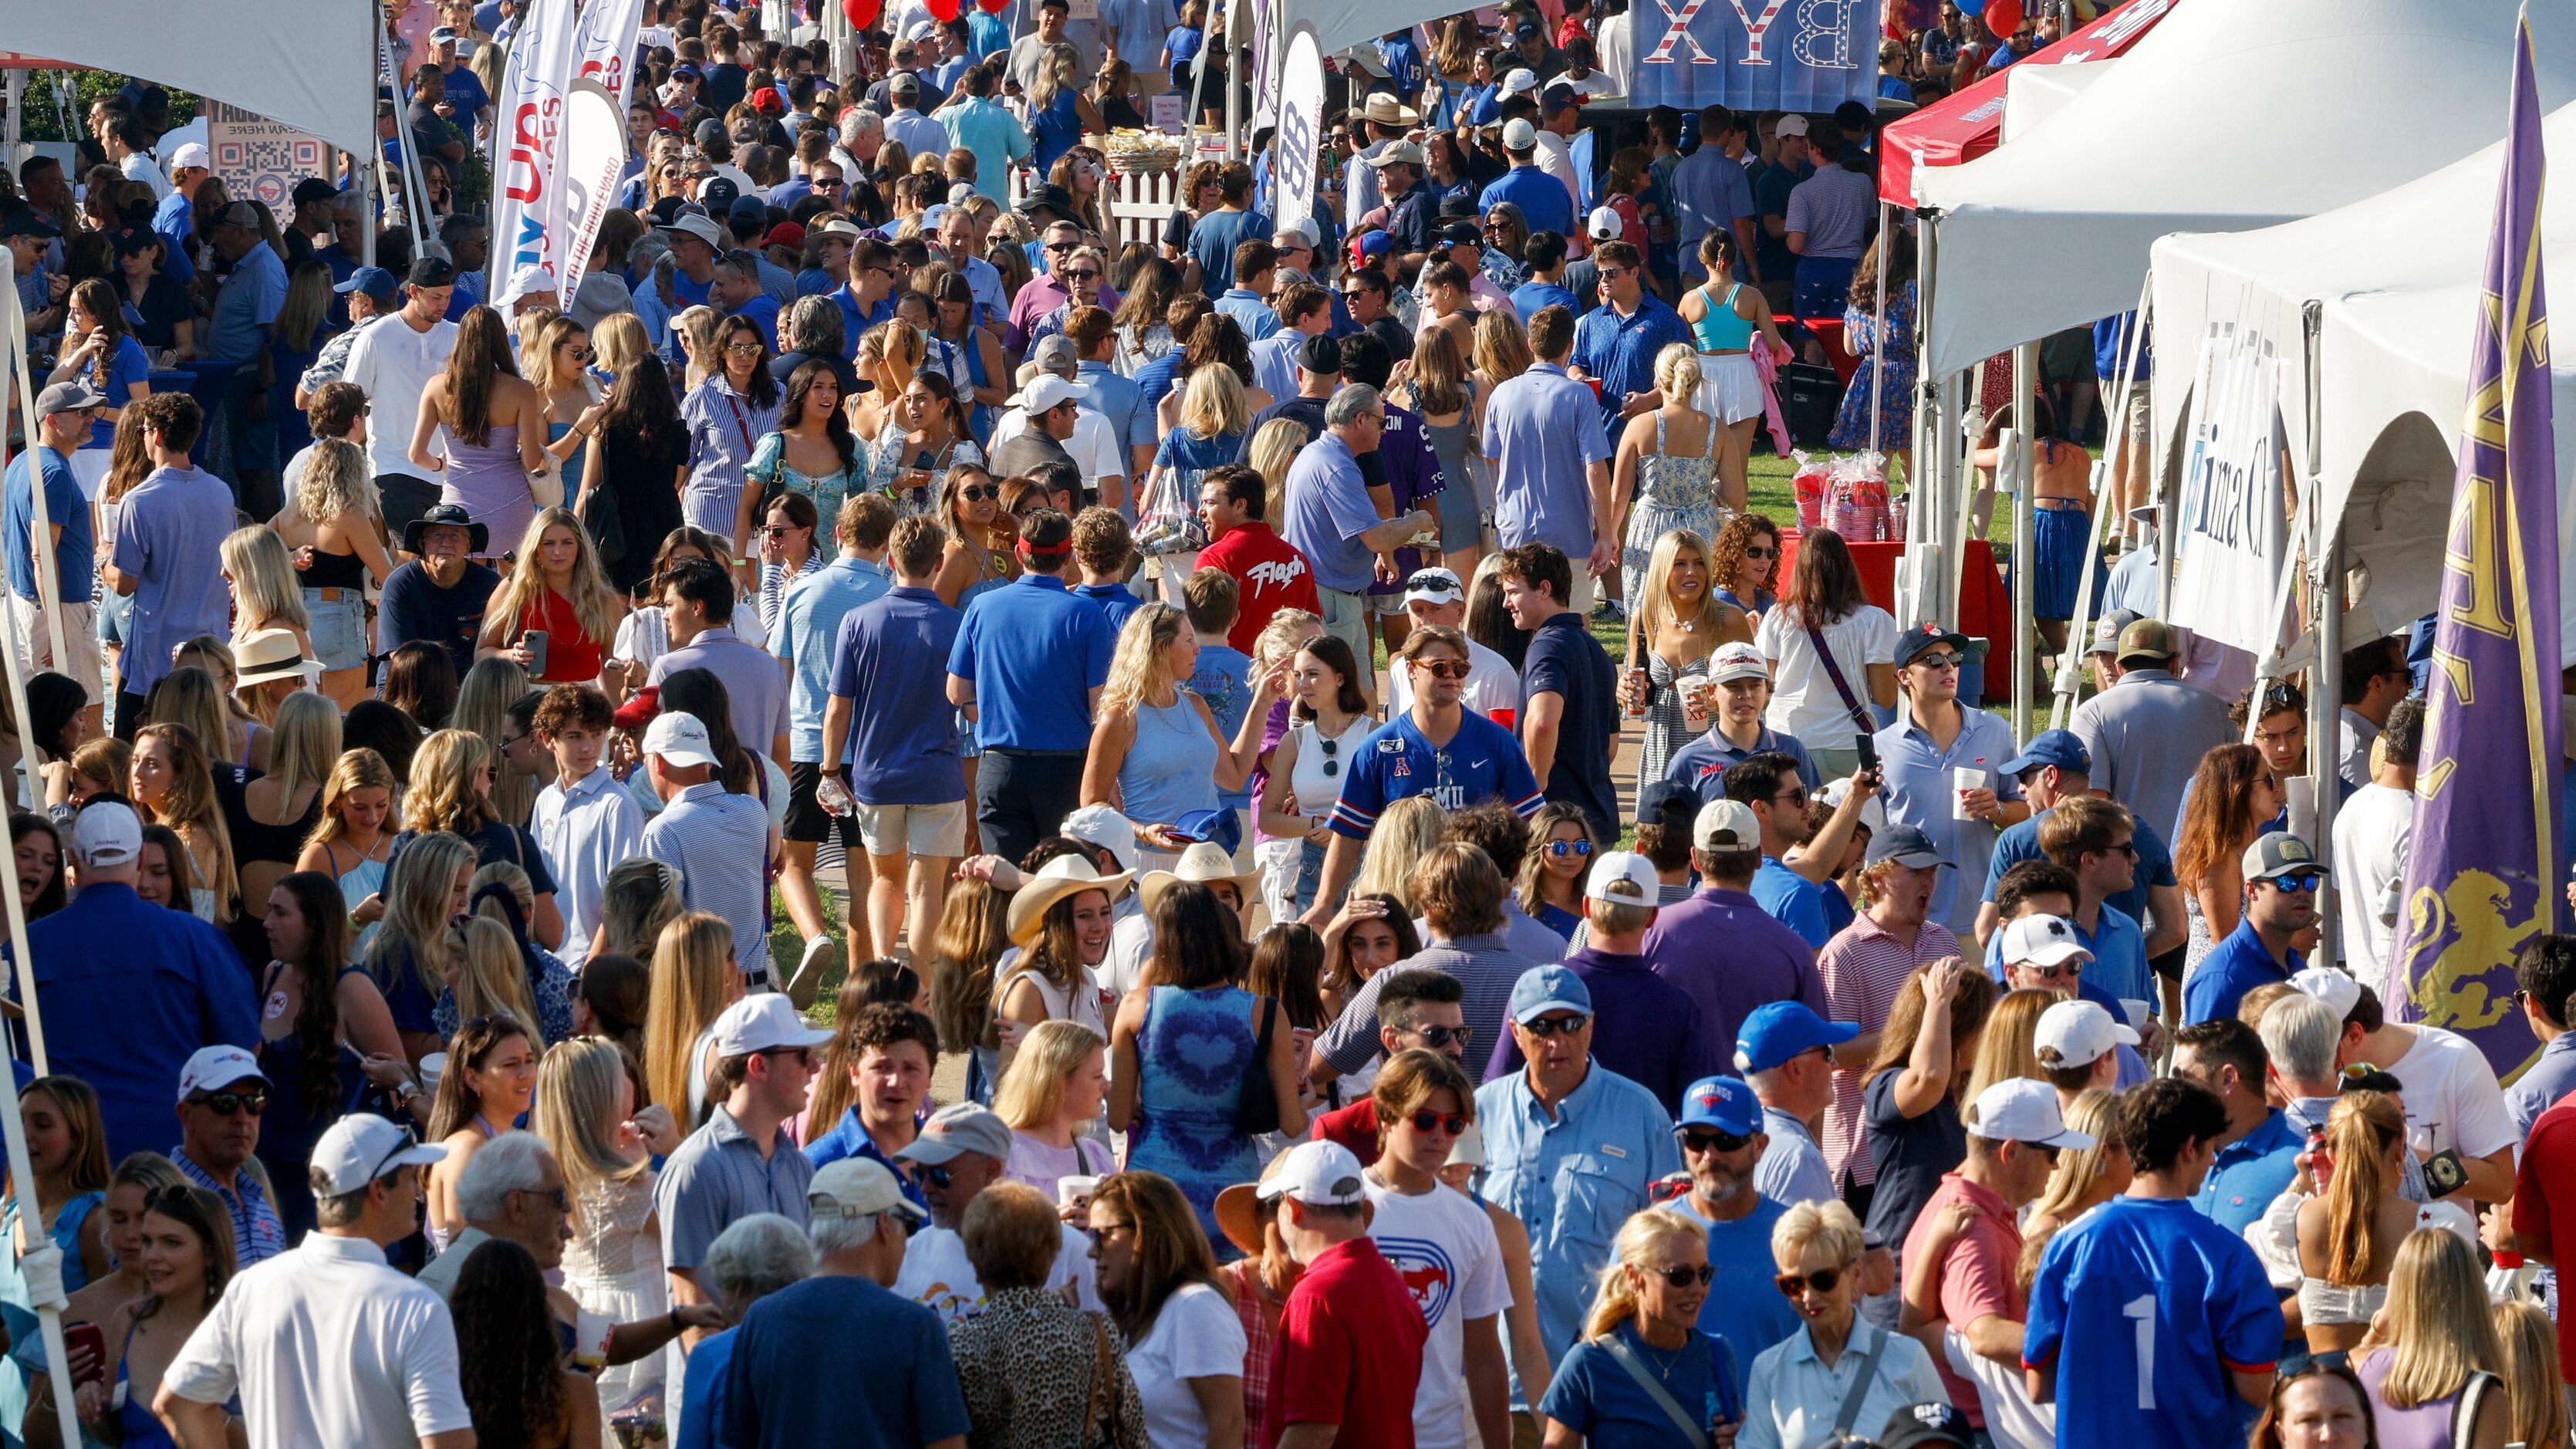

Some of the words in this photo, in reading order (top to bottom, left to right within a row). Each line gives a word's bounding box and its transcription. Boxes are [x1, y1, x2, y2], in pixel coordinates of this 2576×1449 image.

[1410, 64, 1423, 80] 13
[572, 235, 593, 264] THE
[586, 157, 620, 237] BOULEVARD
[1246, 554, 1305, 600] Flash
[1690, 1083, 1734, 1102] MUSTANGS
[2122, 1294, 2156, 1410] 1
[1913, 1403, 1952, 1419] SMU
